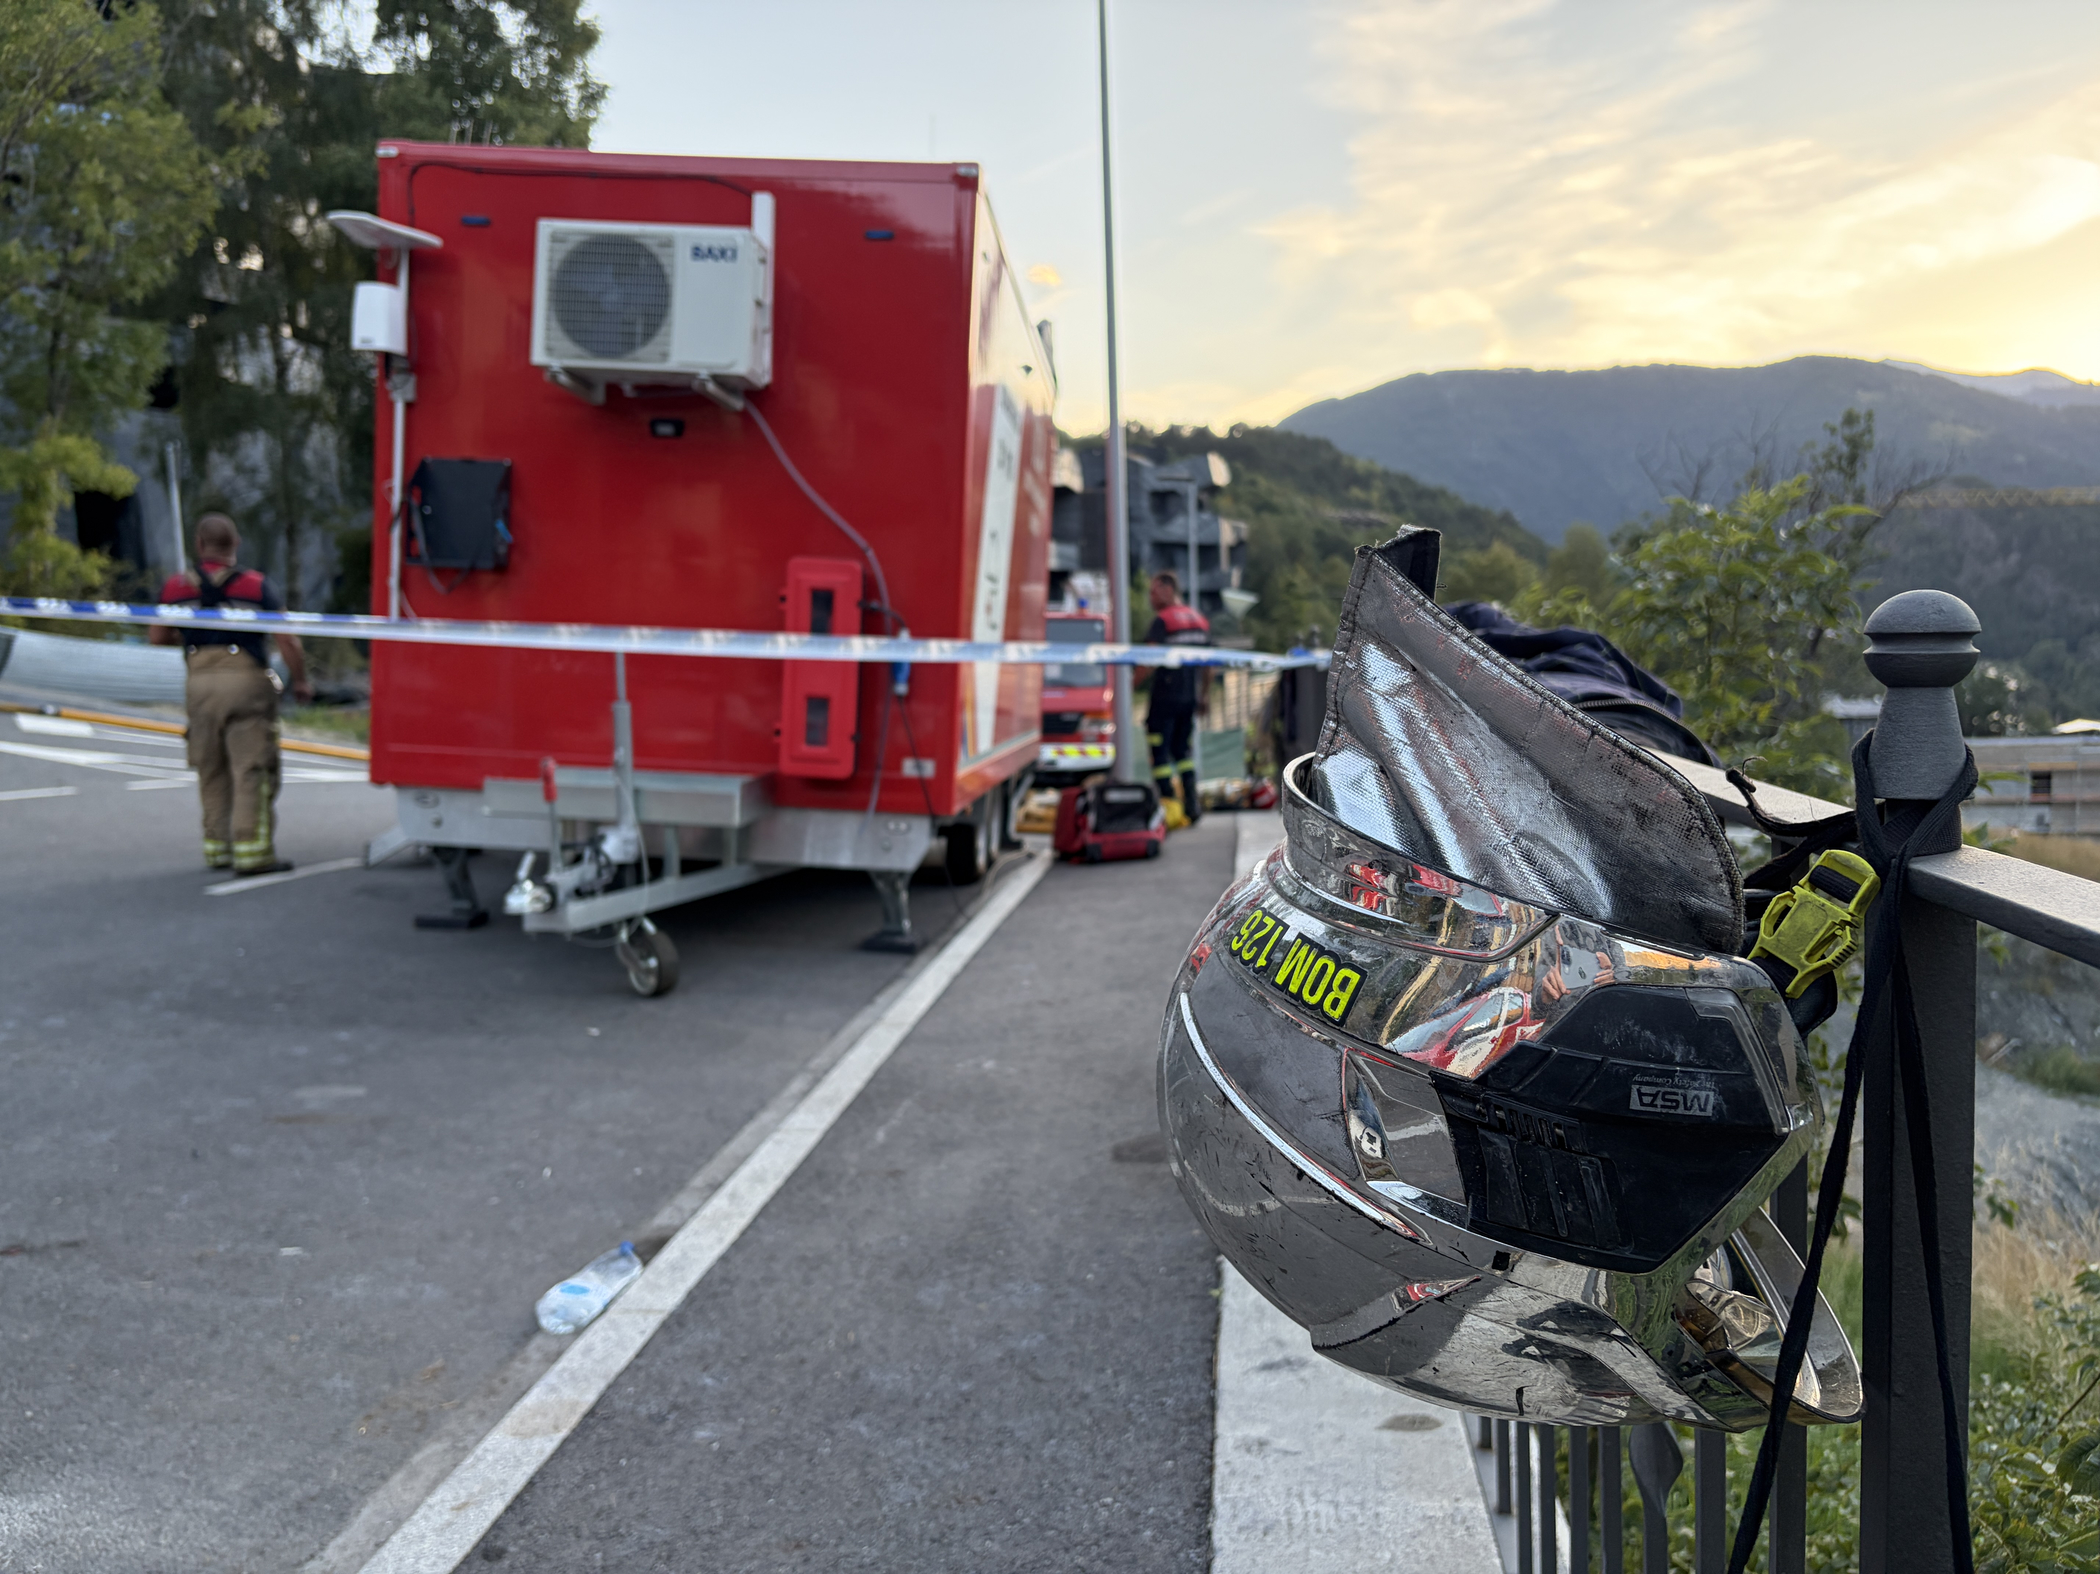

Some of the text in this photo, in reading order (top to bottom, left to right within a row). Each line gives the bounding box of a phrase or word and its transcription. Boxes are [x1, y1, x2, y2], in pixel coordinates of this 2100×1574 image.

[691, 245, 738, 263] BAXI
[1231, 909, 1361, 1020] BOM 126
[1633, 1074, 1671, 1085] Company
[1637, 1088, 1710, 1112] MSA
